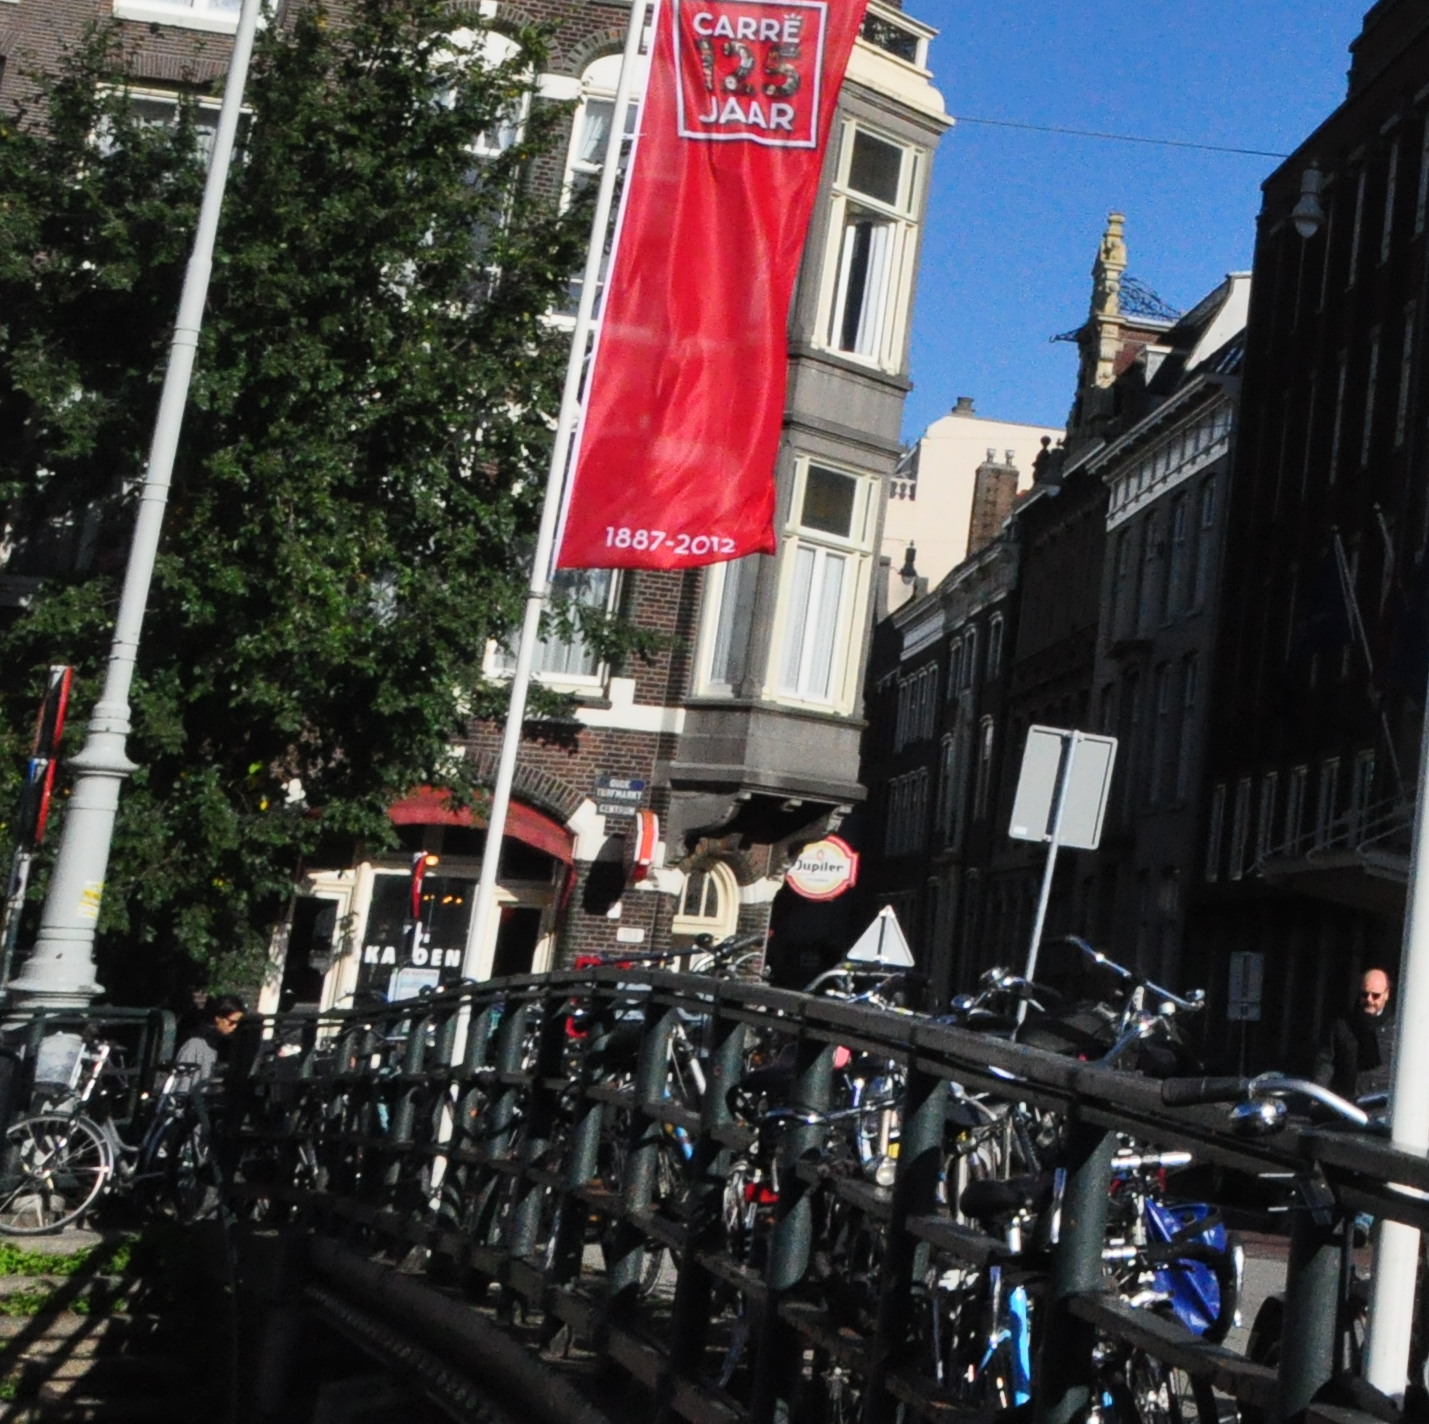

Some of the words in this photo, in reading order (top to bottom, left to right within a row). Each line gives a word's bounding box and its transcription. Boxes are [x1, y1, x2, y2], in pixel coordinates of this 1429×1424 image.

[696, 37, 800, 97] 125
[698, 96, 795, 131] JAAR
[606, 526, 736, 555] 1887-2012
[797, 859, 844, 873] Jupiler
